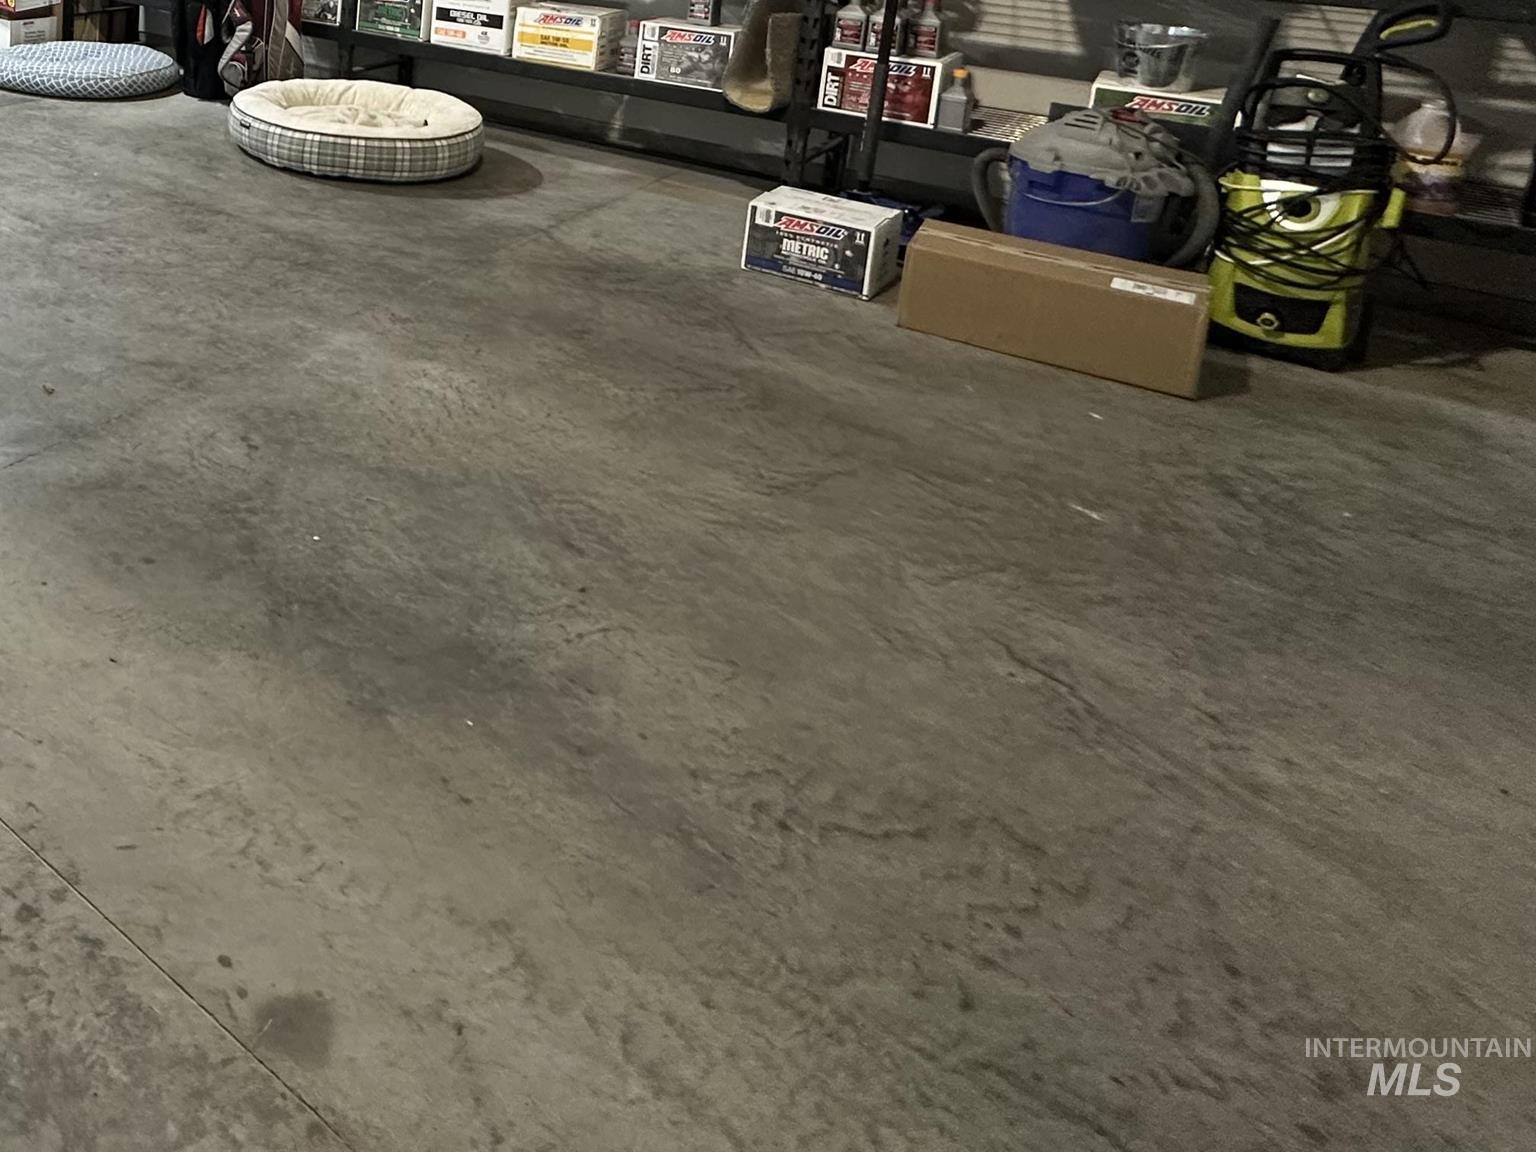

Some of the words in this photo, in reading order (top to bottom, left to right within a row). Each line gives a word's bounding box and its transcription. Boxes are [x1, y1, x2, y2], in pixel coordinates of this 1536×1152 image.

[450, 10, 475, 19] DIESEL
[477, 13, 489, 21] OIL
[538, 14, 583, 26] AMSOIL
[666, 30, 714, 44] AMSOIL
[640, 45, 652, 74] DIRT
[824, 72, 840, 106] DIRT
[1127, 98, 1210, 116] AMSOIL
[777, 218, 845, 239] AMSOIL
[782, 238, 830, 260] METRIC
